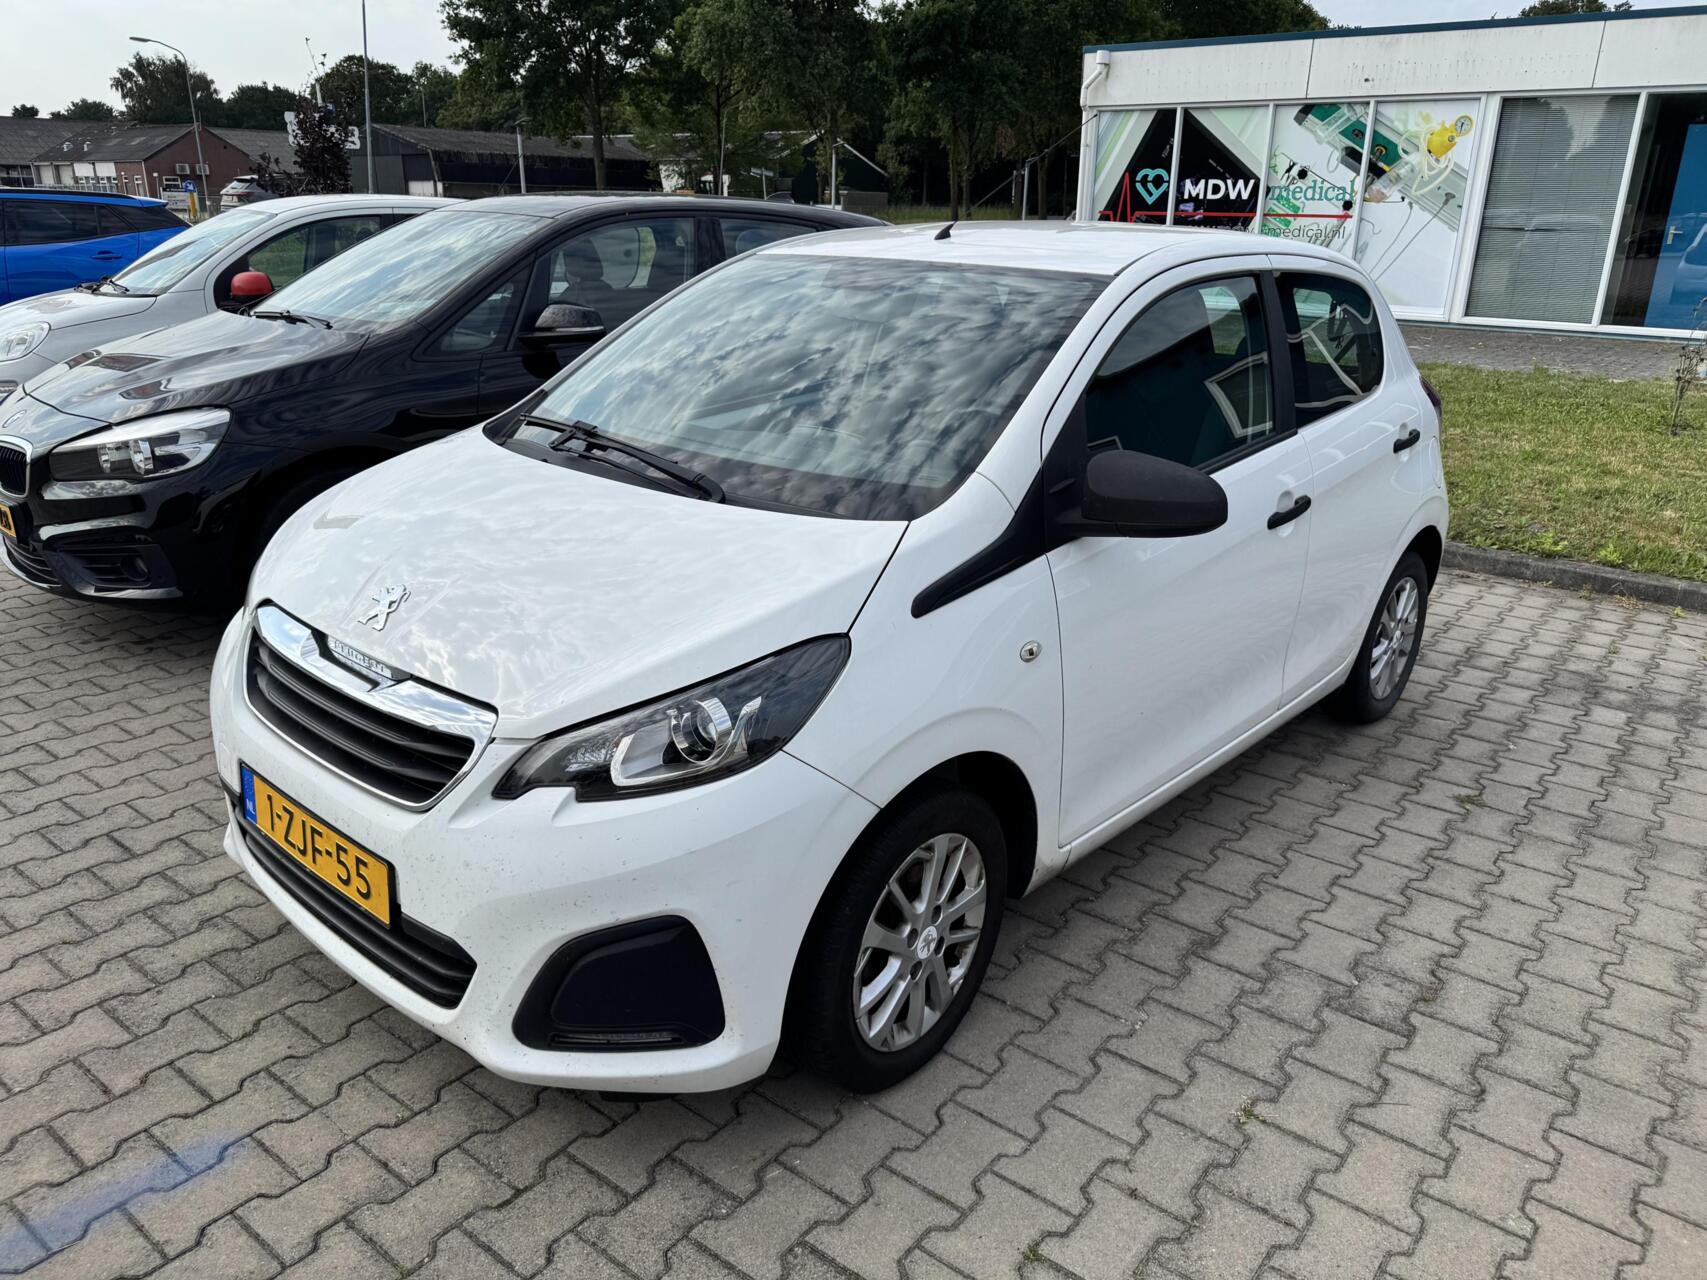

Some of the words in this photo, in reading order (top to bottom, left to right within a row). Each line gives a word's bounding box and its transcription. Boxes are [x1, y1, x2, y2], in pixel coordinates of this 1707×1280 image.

[1184, 179, 1255, 200] MDW
[1270, 180, 1355, 201] medical
[266, 793, 372, 901] 1-ZJF-55
